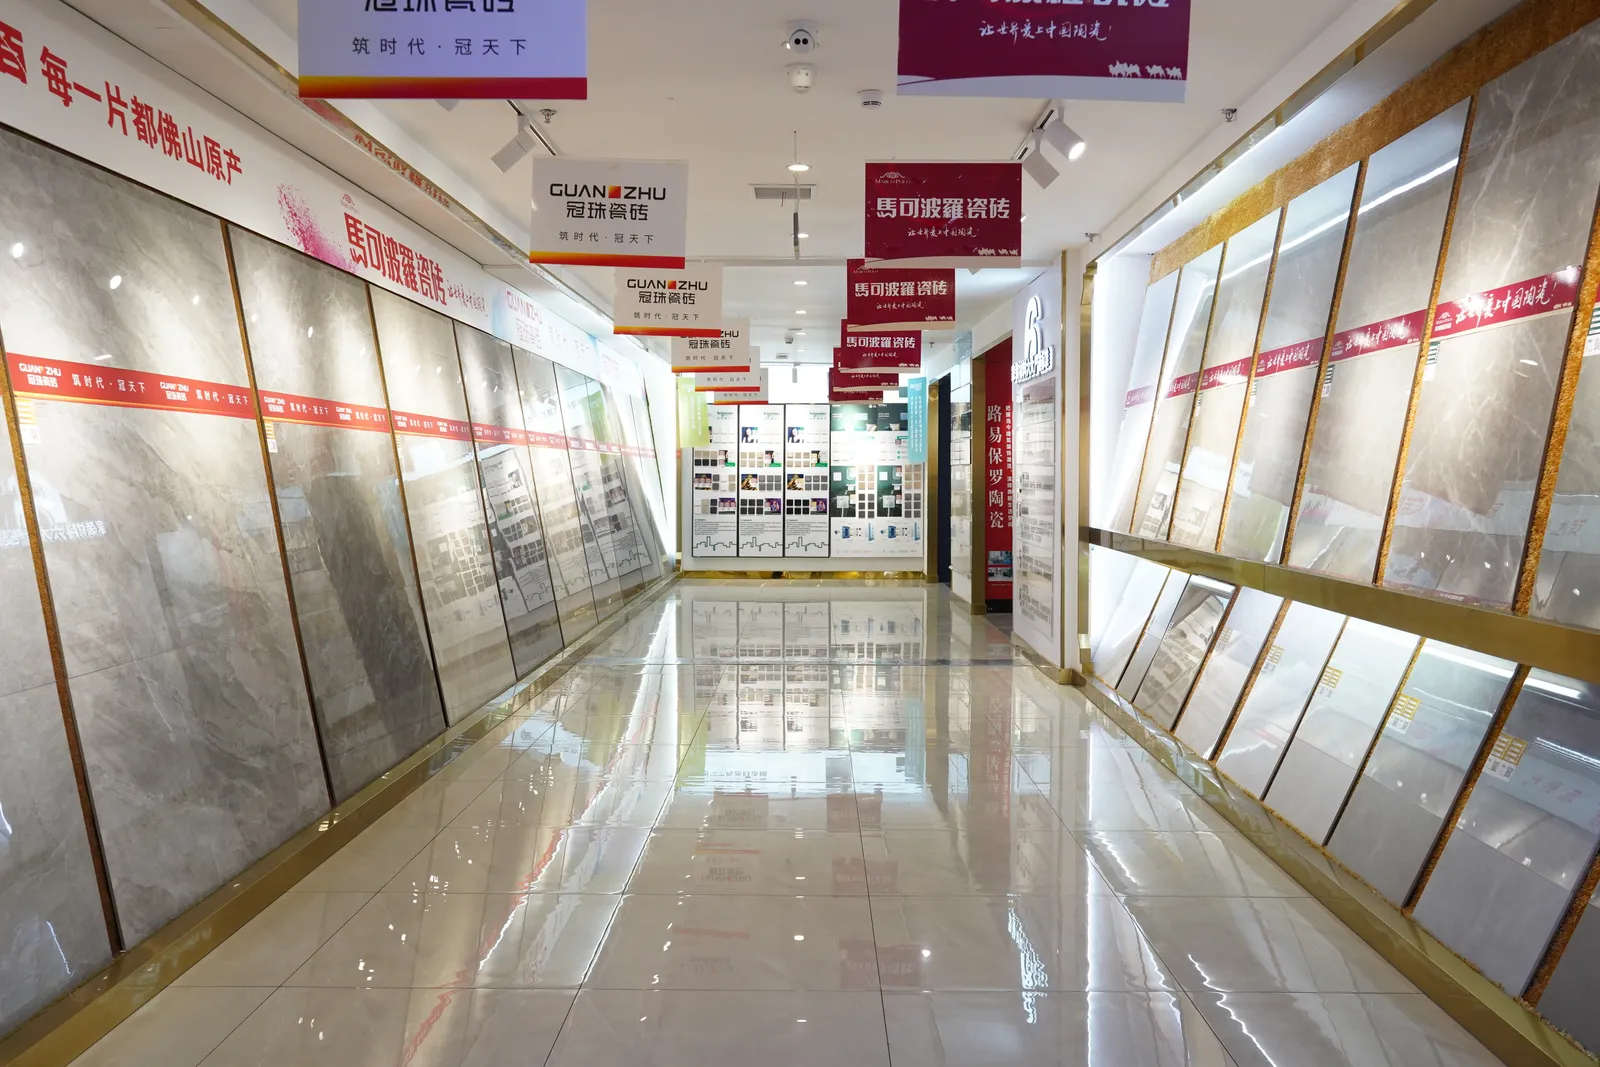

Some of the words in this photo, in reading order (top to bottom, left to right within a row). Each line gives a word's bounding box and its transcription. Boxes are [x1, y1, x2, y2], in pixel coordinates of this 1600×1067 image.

[40, 45, 243, 186] 每一片都佛山原产
[566, 201, 649, 221] 冠珠瓷砖
[876, 197, 1010, 219] 馬可波羅瓷砖
[344, 212, 447, 306] 馬可波羅瓷砖
[639, 291, 696, 305] 冠珠瓷砖
[855, 280, 947, 298] 馬可波羅瓷砖
[689, 340, 731, 349] 冠珠瓷砖
[846, 336, 916, 349] 馬可波羅瓷砖
[987, 404, 1004, 529] 路易保罗陶瓷
